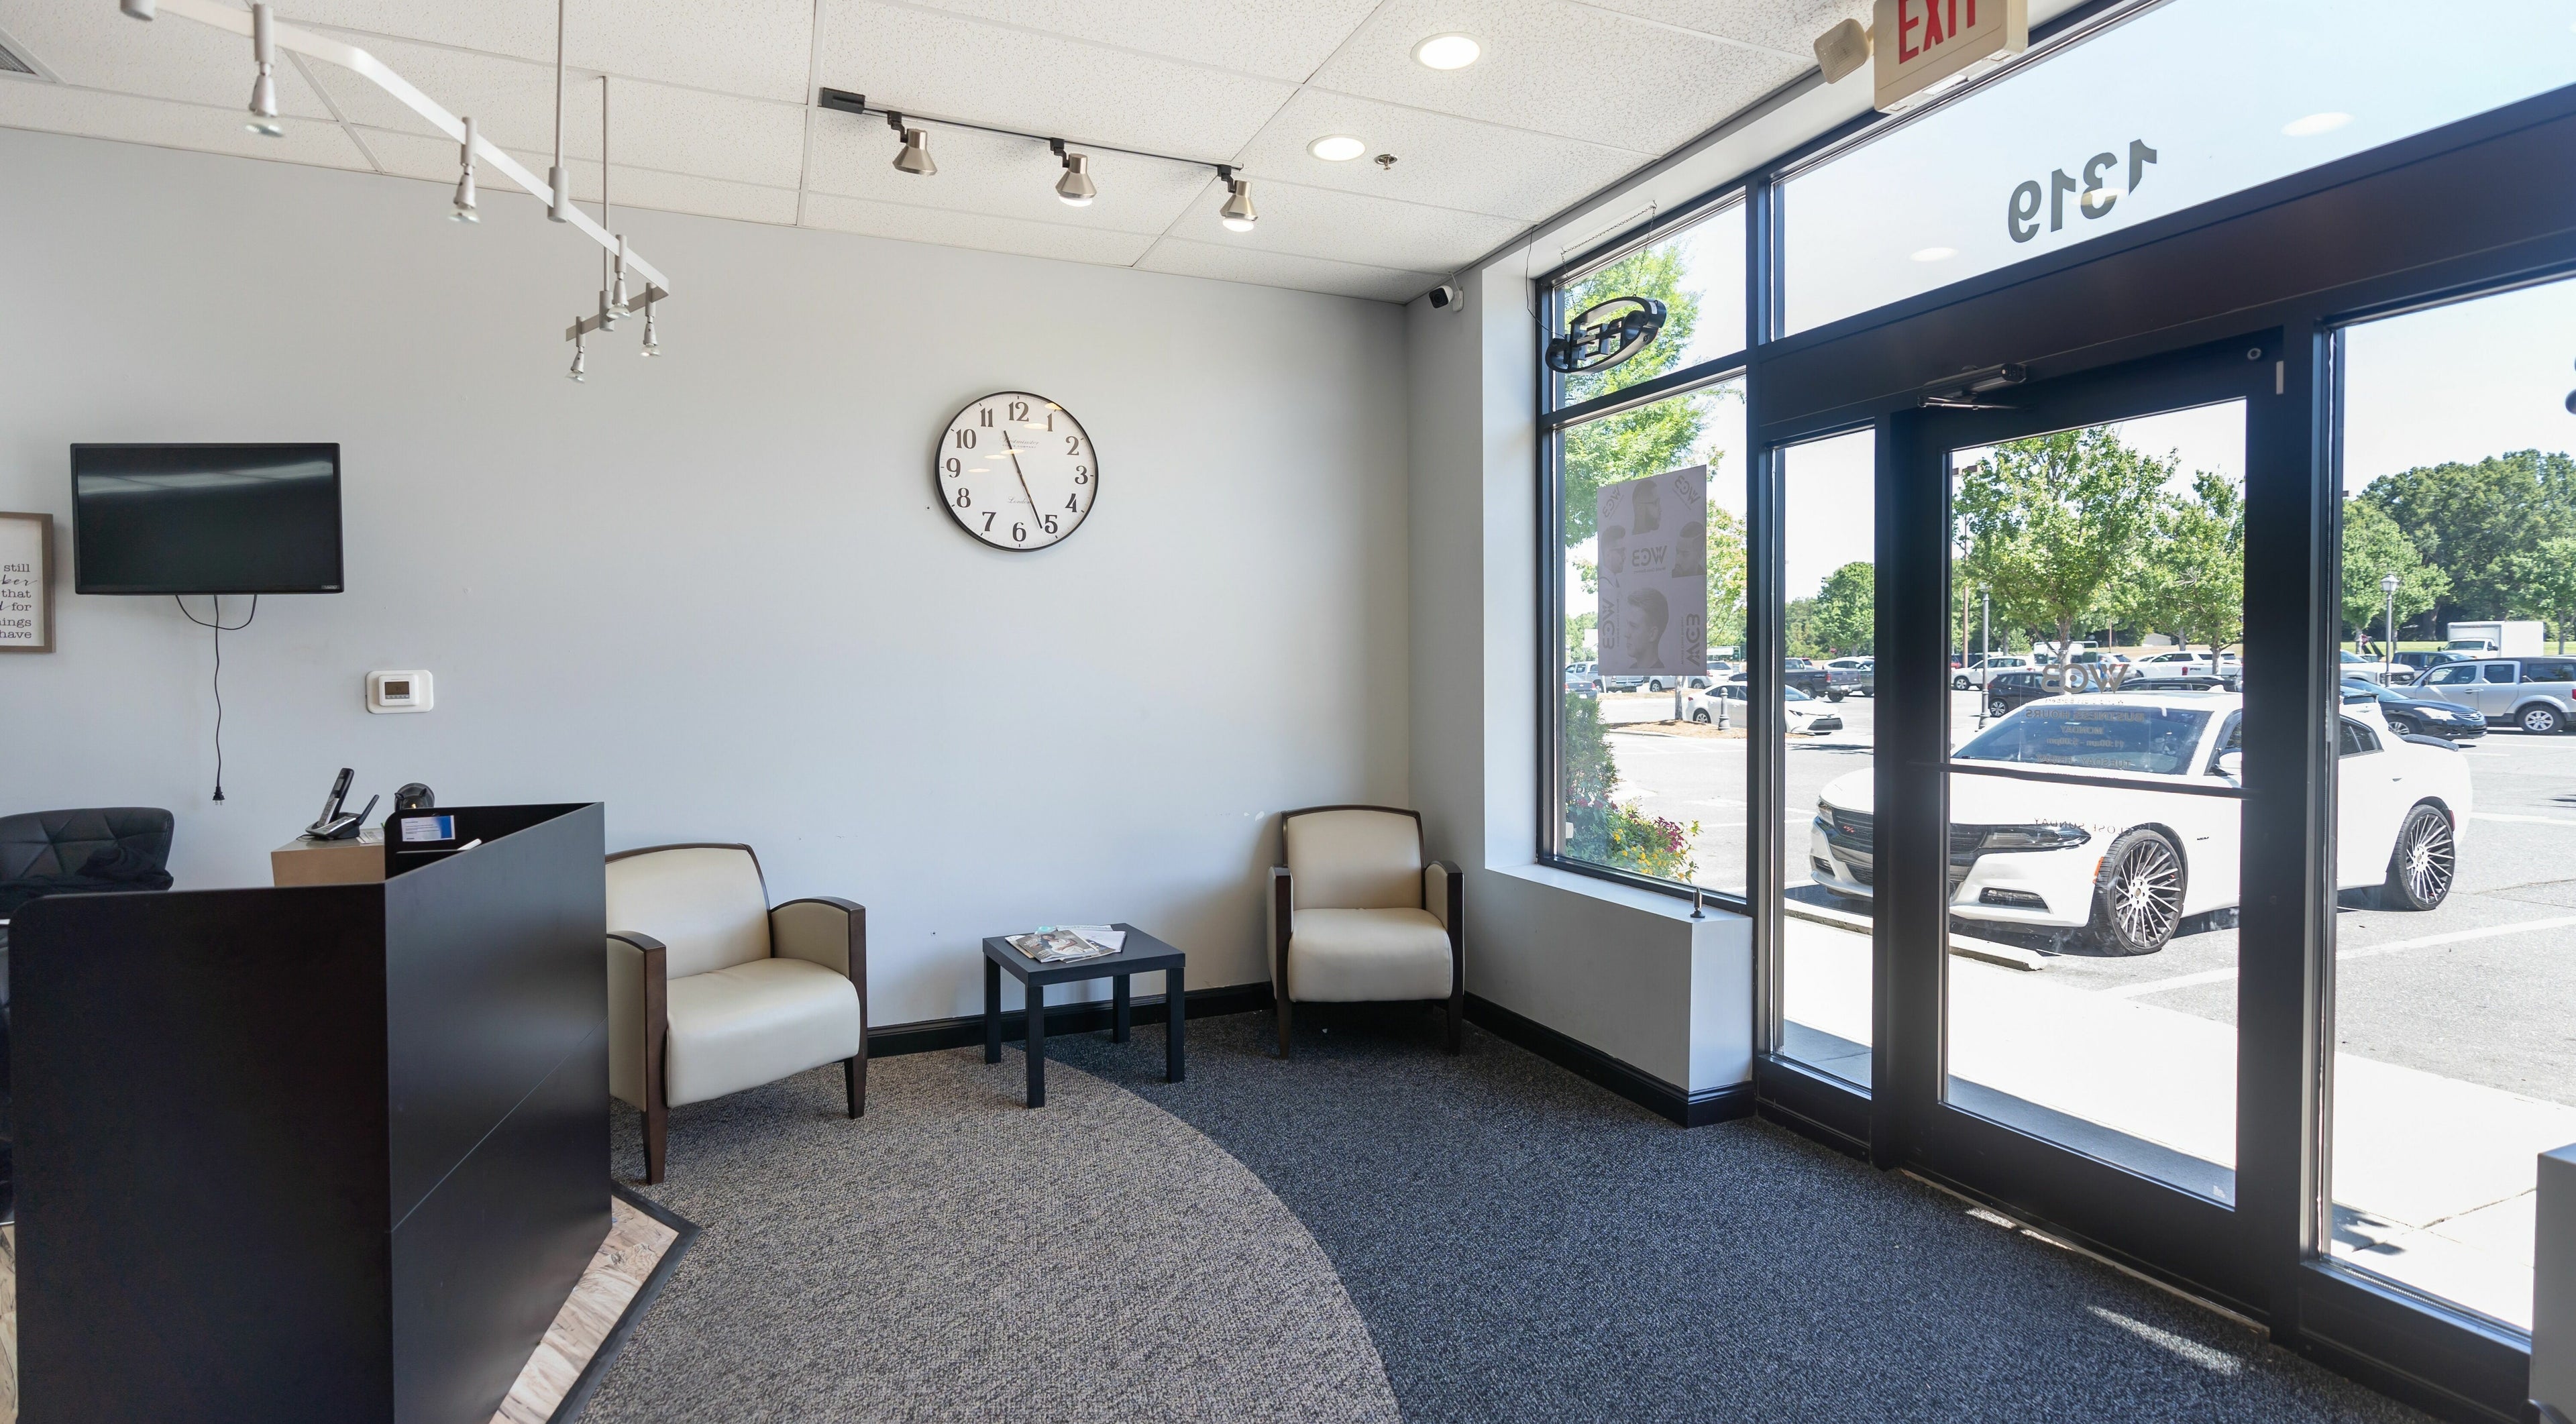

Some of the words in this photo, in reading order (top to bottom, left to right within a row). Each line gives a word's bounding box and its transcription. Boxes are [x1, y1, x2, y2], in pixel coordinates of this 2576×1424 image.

[980, 407, 994, 427] 11
[1008, 402, 1029, 422] 12
[1046, 413, 1053, 432] 1
[956, 429, 977, 449] 10
[1065, 436, 1079, 456] 2
[946, 457, 961, 478] 9
[1075, 465, 1088, 484] 3
[956, 488, 971, 508] 8
[1065, 493, 1077, 512] 4
[981, 511, 997, 532] 7
[1044, 514, 1058, 534] 5
[1012, 522, 1026, 541] 6
[3, 563, 31, 572] still
[1, 589, 32, 598] that
[11, 602, 32, 611] for
[0, 618, 32, 628] ings
[0, 630, 32, 639] have
